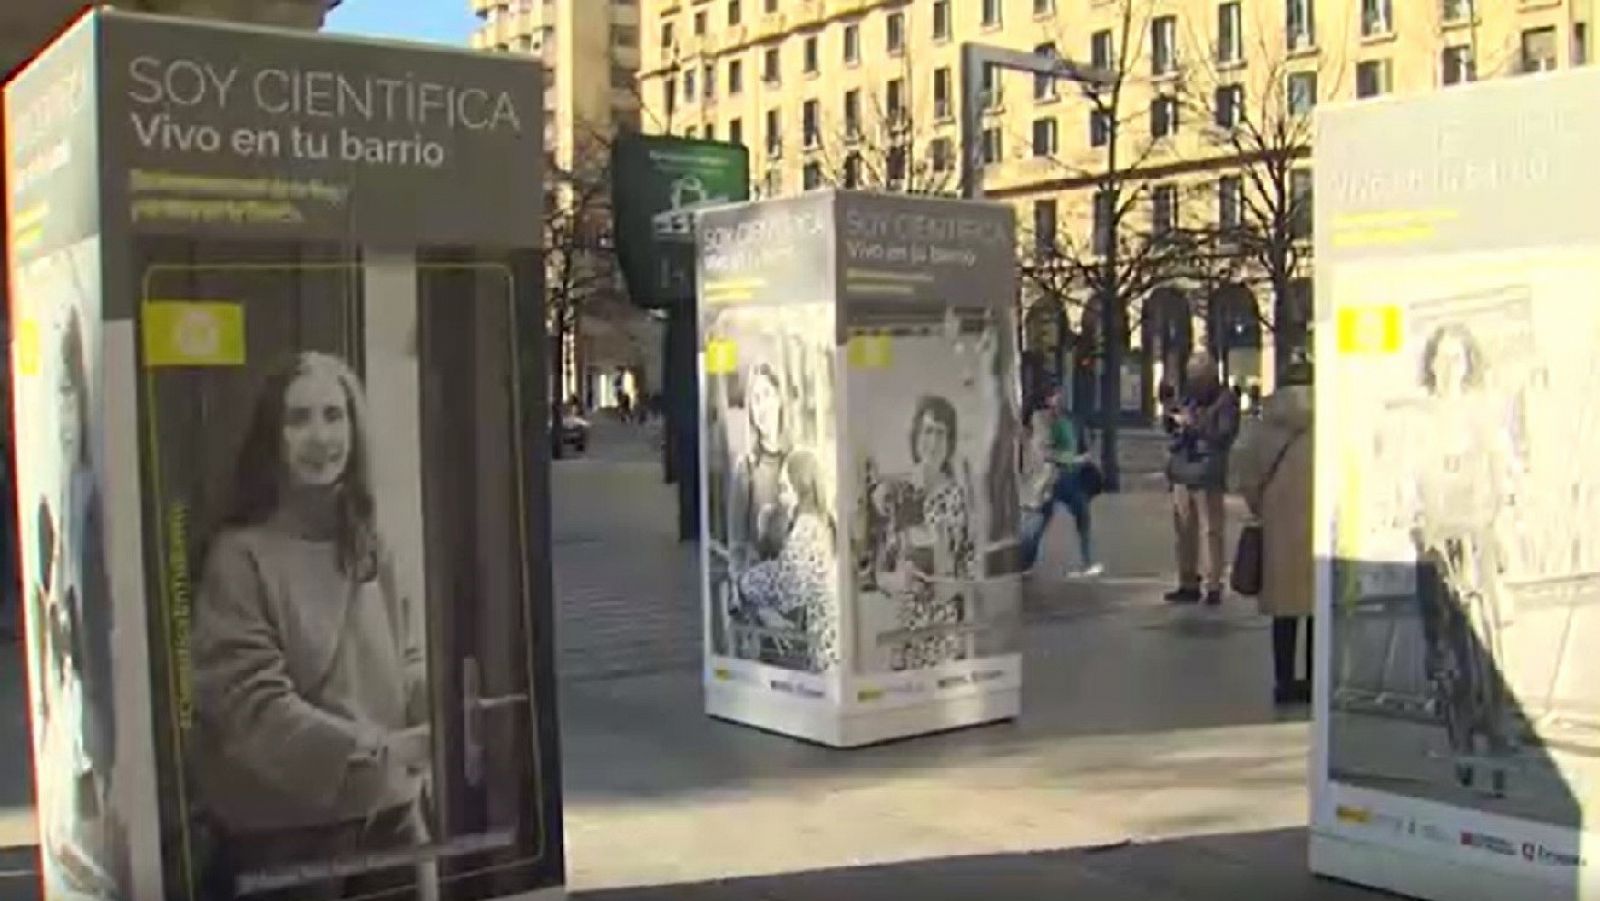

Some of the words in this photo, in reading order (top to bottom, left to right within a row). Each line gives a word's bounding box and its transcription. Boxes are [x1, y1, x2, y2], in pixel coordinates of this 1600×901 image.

[128, 56, 239, 108] SOY
[130, 111, 221, 151] Vivo
[231, 127, 280, 158] en
[292, 125, 329, 160] tu
[341, 126, 445, 168] barrio
